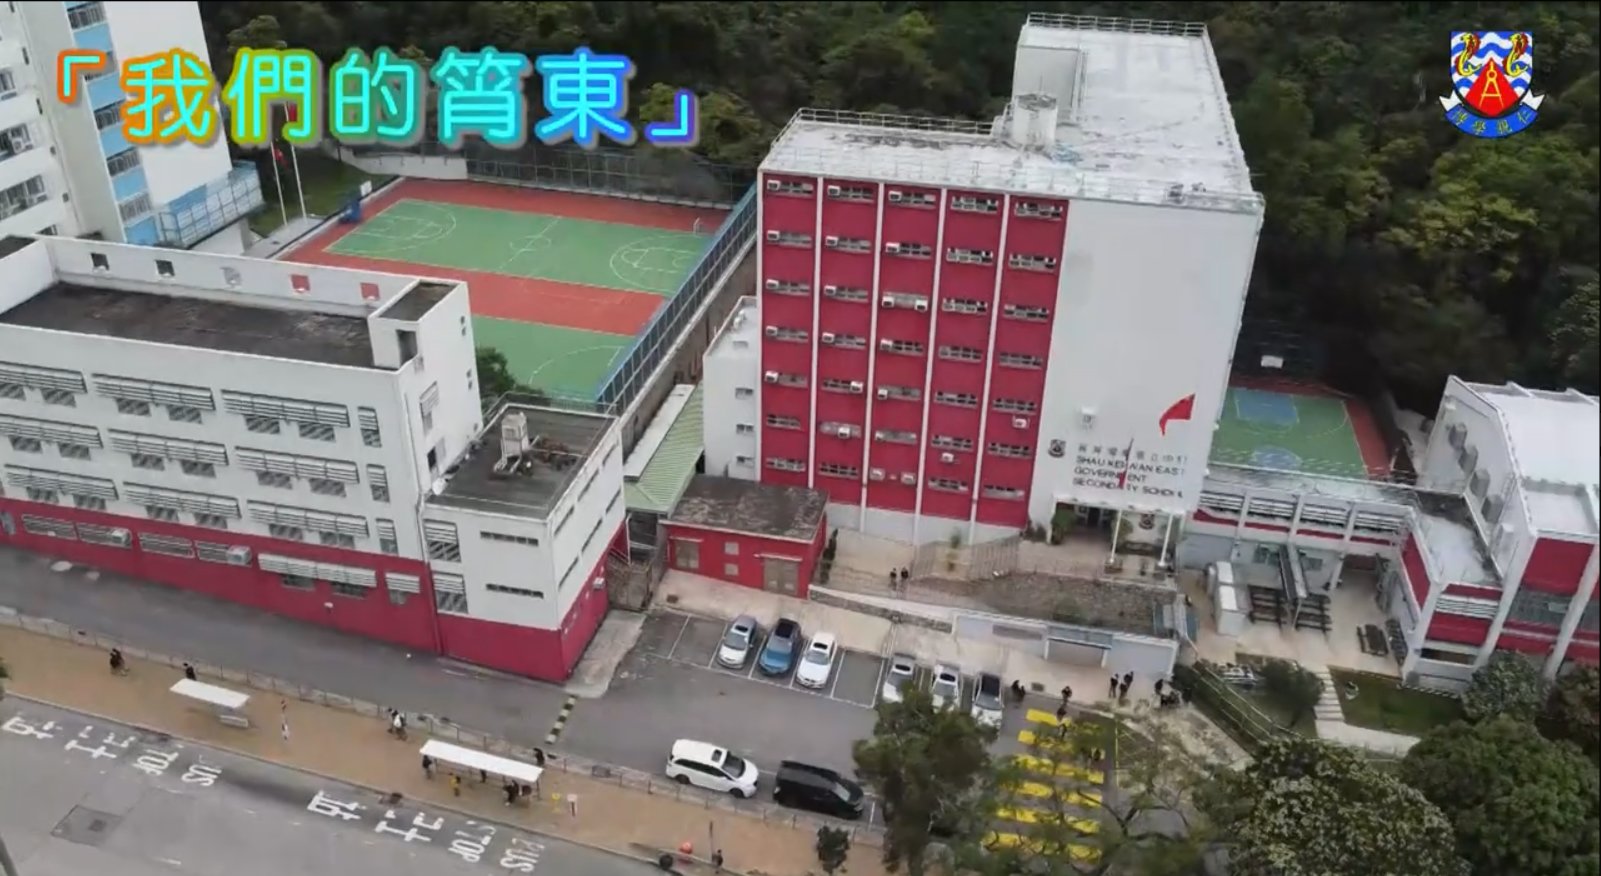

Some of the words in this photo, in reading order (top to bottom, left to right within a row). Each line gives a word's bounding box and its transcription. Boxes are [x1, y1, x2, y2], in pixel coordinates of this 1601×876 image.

[1074, 466, 1148, 483] GOVERNENT
[133, 744, 183, 776] TOP
[181, 755, 222, 787] US
